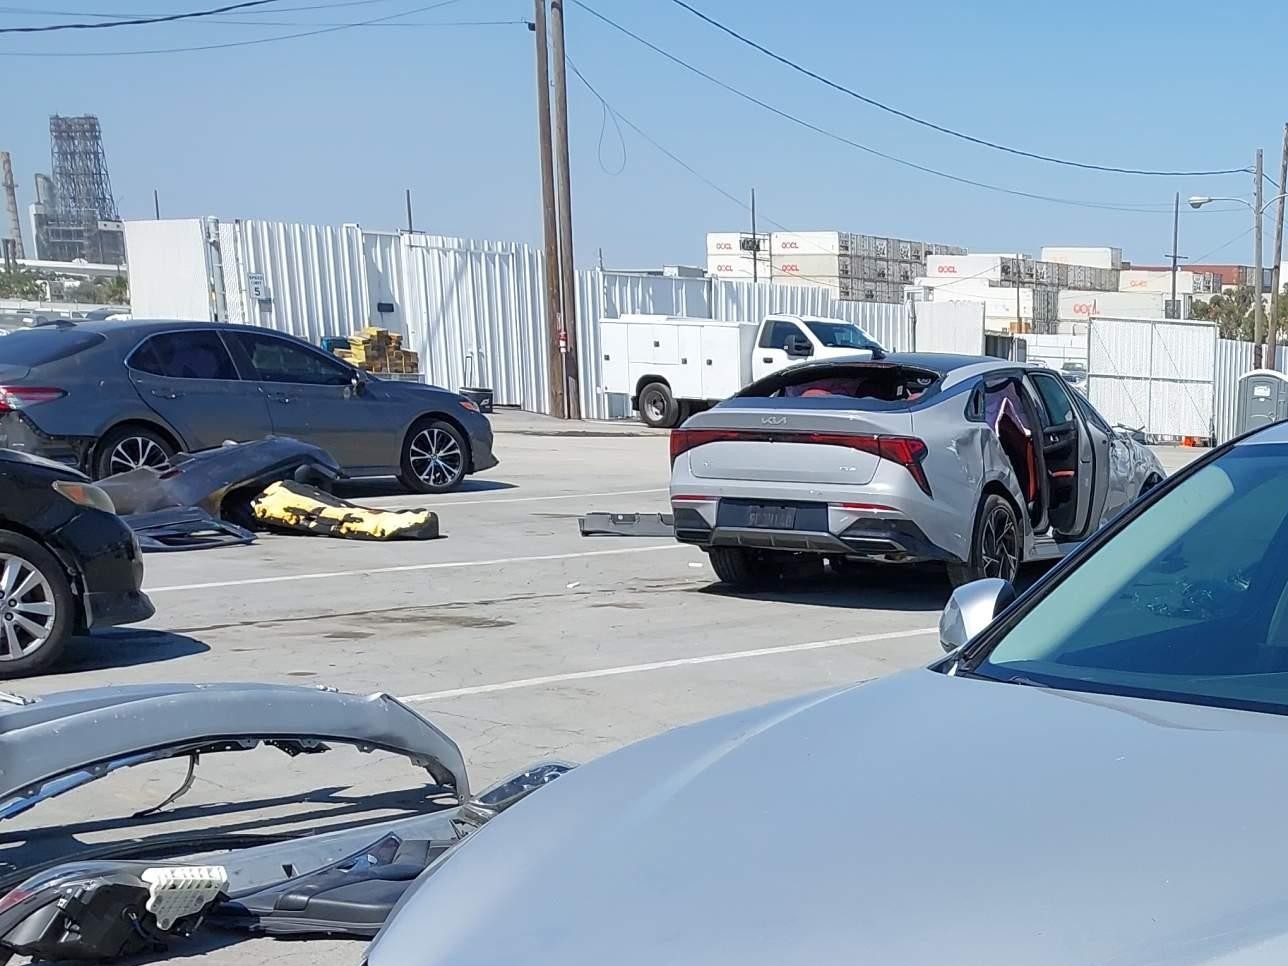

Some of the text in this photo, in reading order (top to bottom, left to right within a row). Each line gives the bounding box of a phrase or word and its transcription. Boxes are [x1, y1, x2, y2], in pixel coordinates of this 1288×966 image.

[716, 242, 732, 250] OOCL
[781, 241, 799, 249] OOCL
[717, 264, 733, 272] OOCL
[781, 264, 800, 272] OOCL
[254, 287, 261, 296] 5
